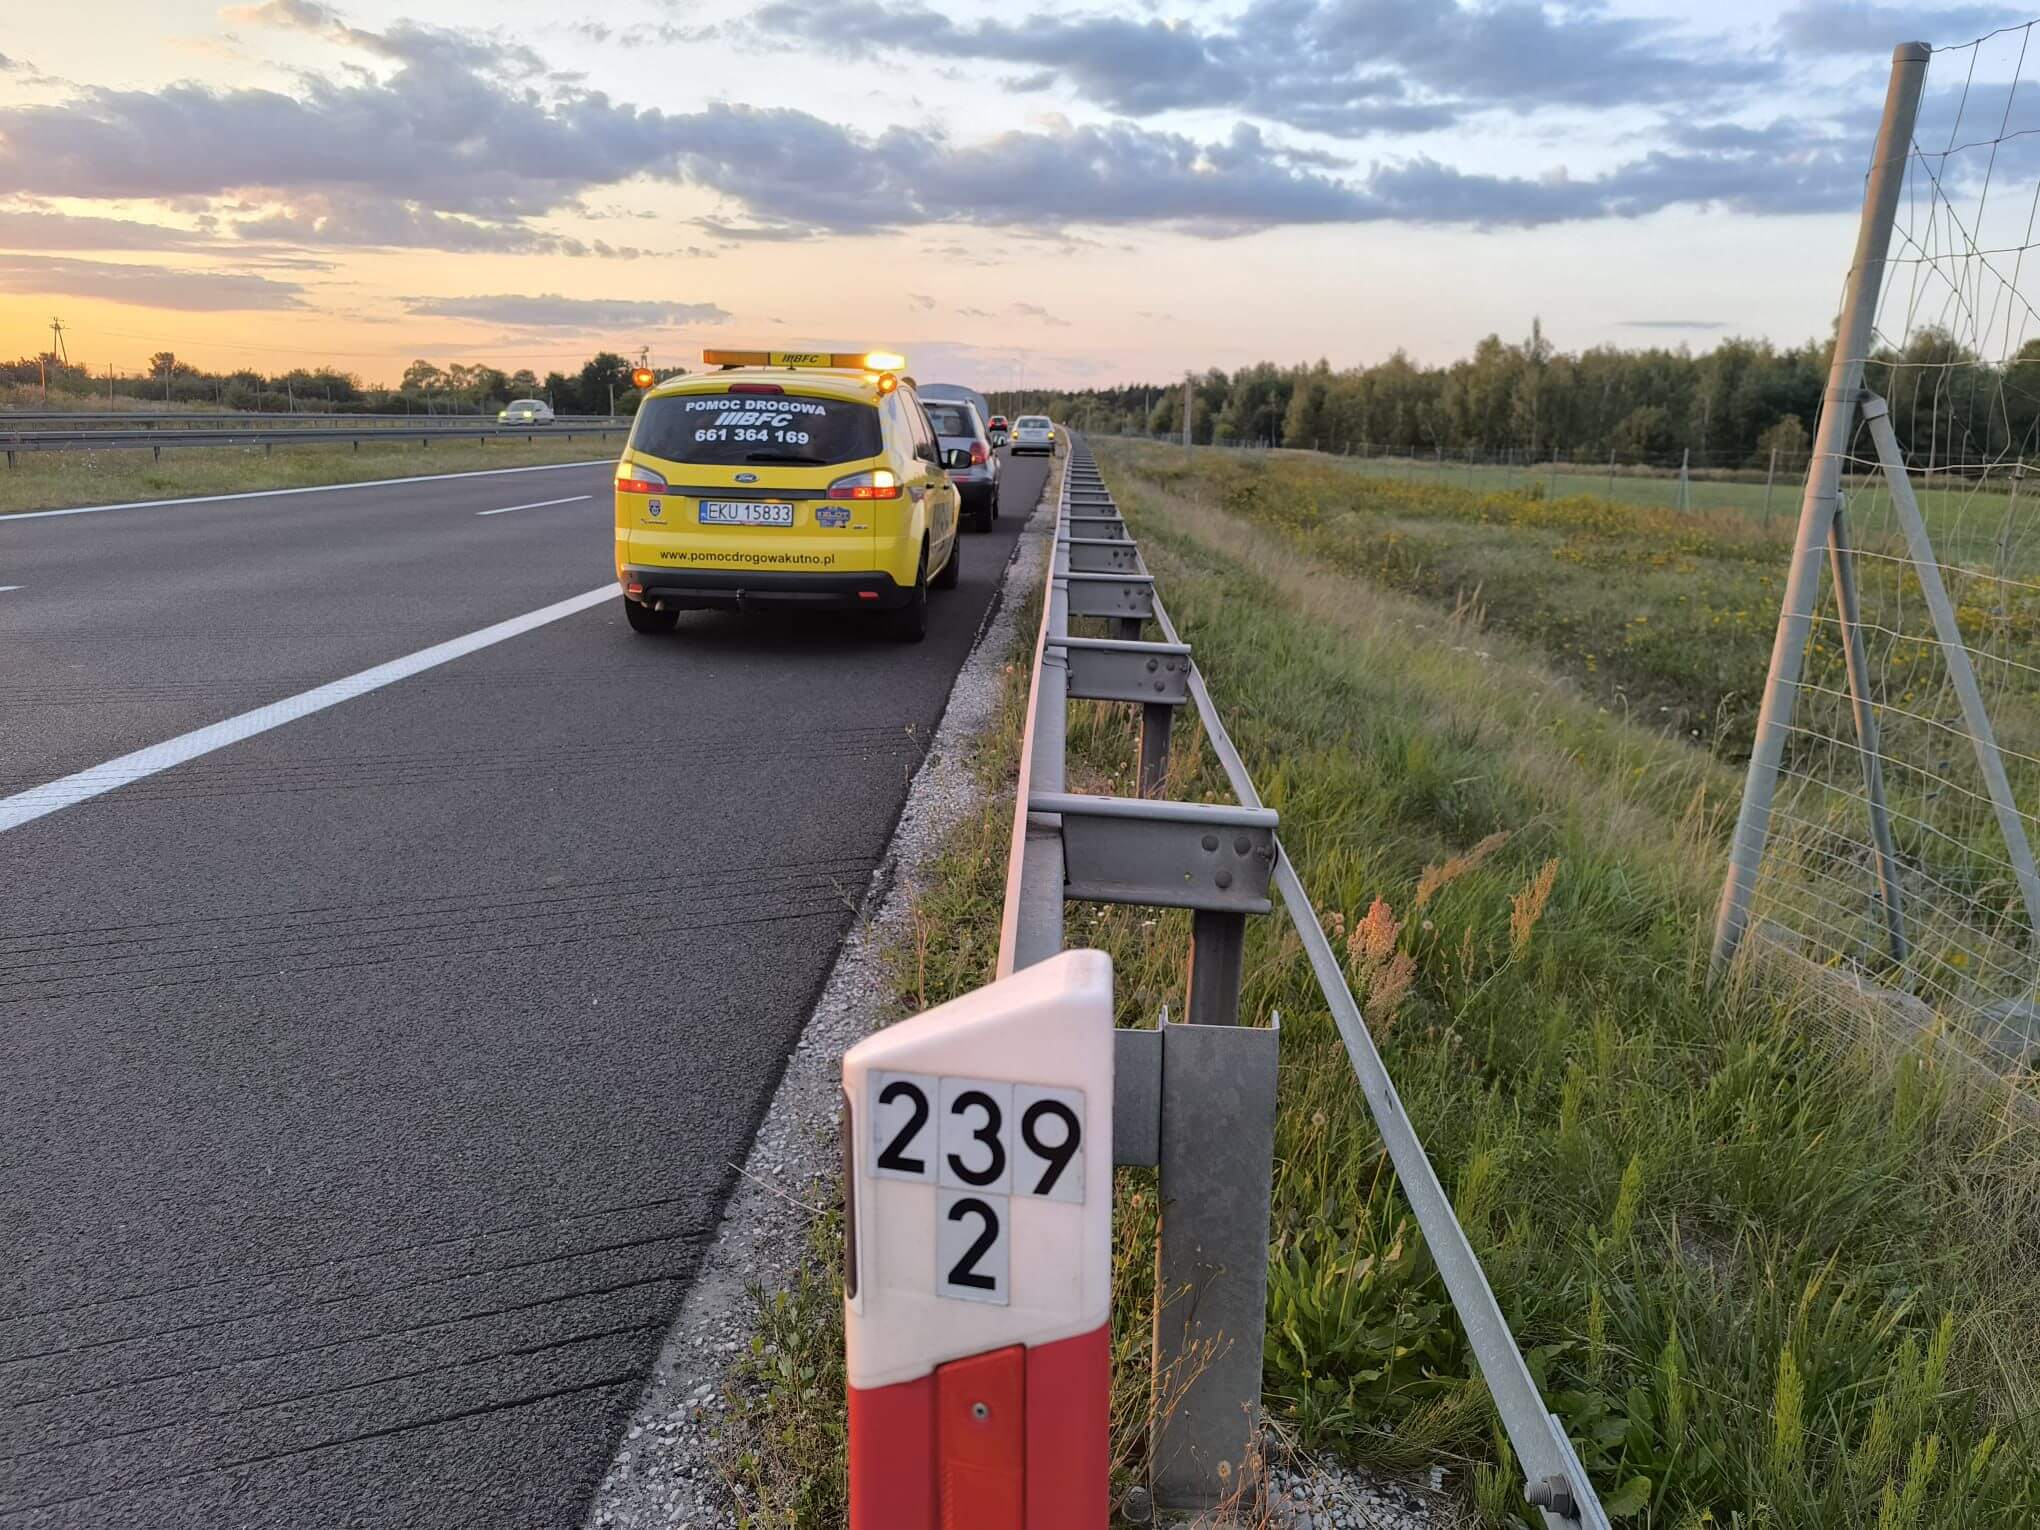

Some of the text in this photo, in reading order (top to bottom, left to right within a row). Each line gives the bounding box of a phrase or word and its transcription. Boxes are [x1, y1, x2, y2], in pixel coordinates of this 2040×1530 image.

[685, 400, 826, 416] POMOC DROGOWA
[695, 428, 809, 444] 661 364 169
[709, 503, 790, 521] EKU 15833
[660, 550, 835, 566] www.pomocdrogowakutno.pl
[877, 1081, 1081, 1195] 239
[947, 1198, 1000, 1291] 2
